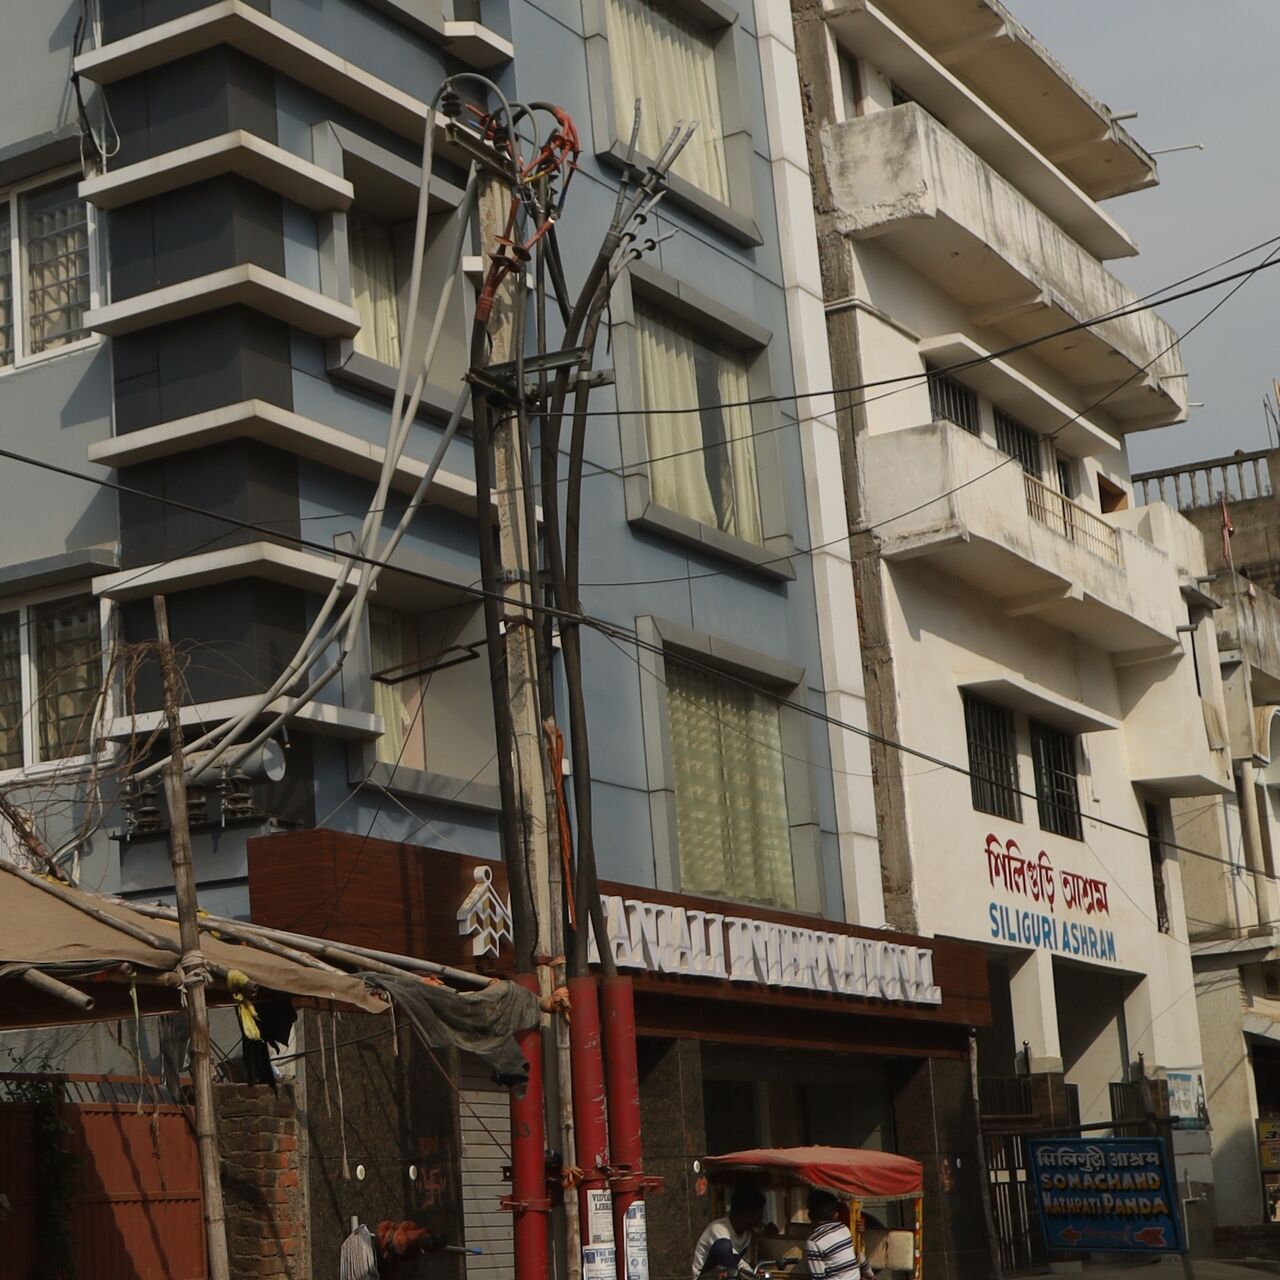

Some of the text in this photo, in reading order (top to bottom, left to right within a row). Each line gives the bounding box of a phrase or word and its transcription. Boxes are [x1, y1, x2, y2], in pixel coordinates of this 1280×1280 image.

[984, 833, 1110, 917] শিলিগুড়ি আশ্রম
[725, 916, 943, 1006] INTERNATIONAL
[989, 902, 1117, 962] SILIGURI ASHRAM
[1110, 1151, 1161, 1167] आश्रम
[1103, 1193, 1169, 1216] PANDA
